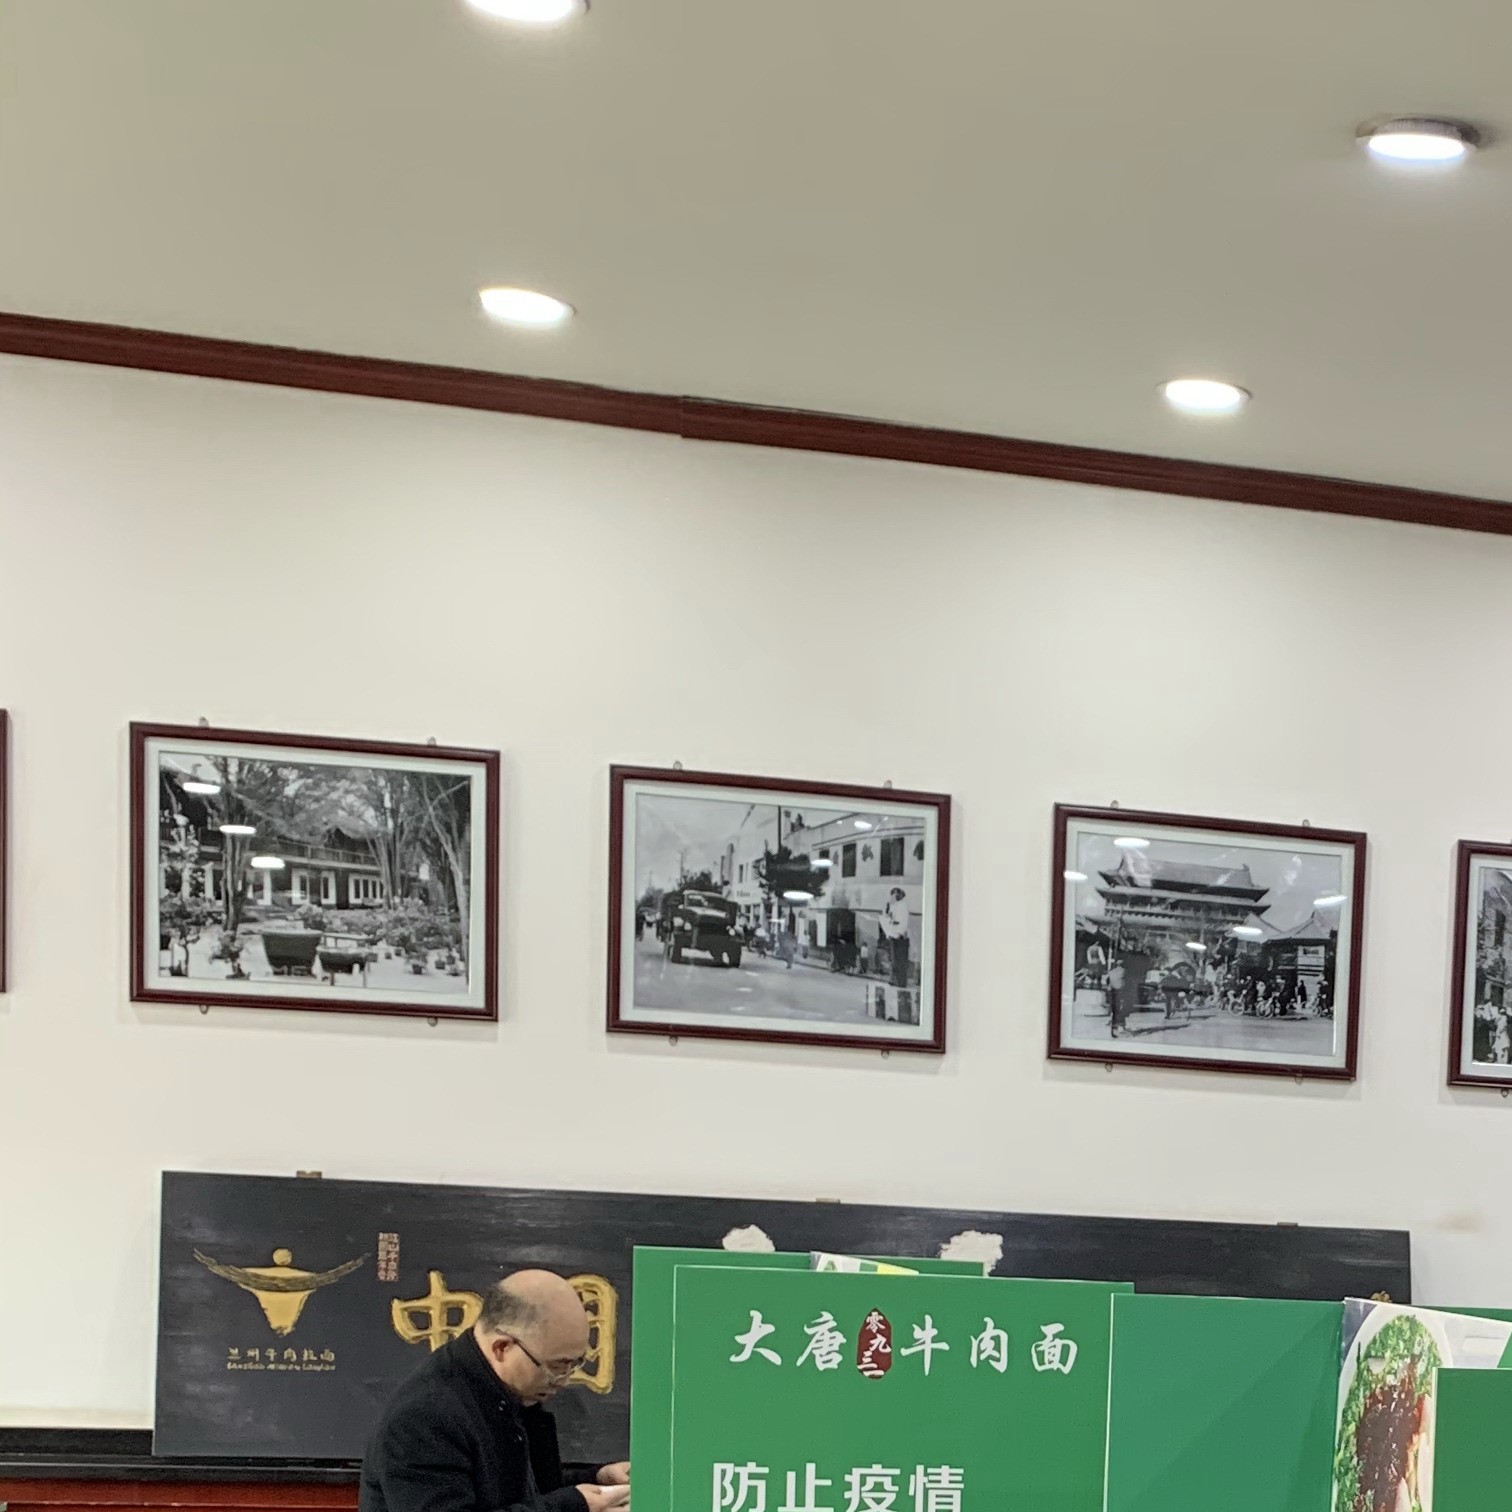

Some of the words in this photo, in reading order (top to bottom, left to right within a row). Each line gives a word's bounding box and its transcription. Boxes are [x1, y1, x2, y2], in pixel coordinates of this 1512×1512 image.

[729, 1309, 847, 1372] 大唐
[900, 1313, 1079, 1376] 牛肉面
